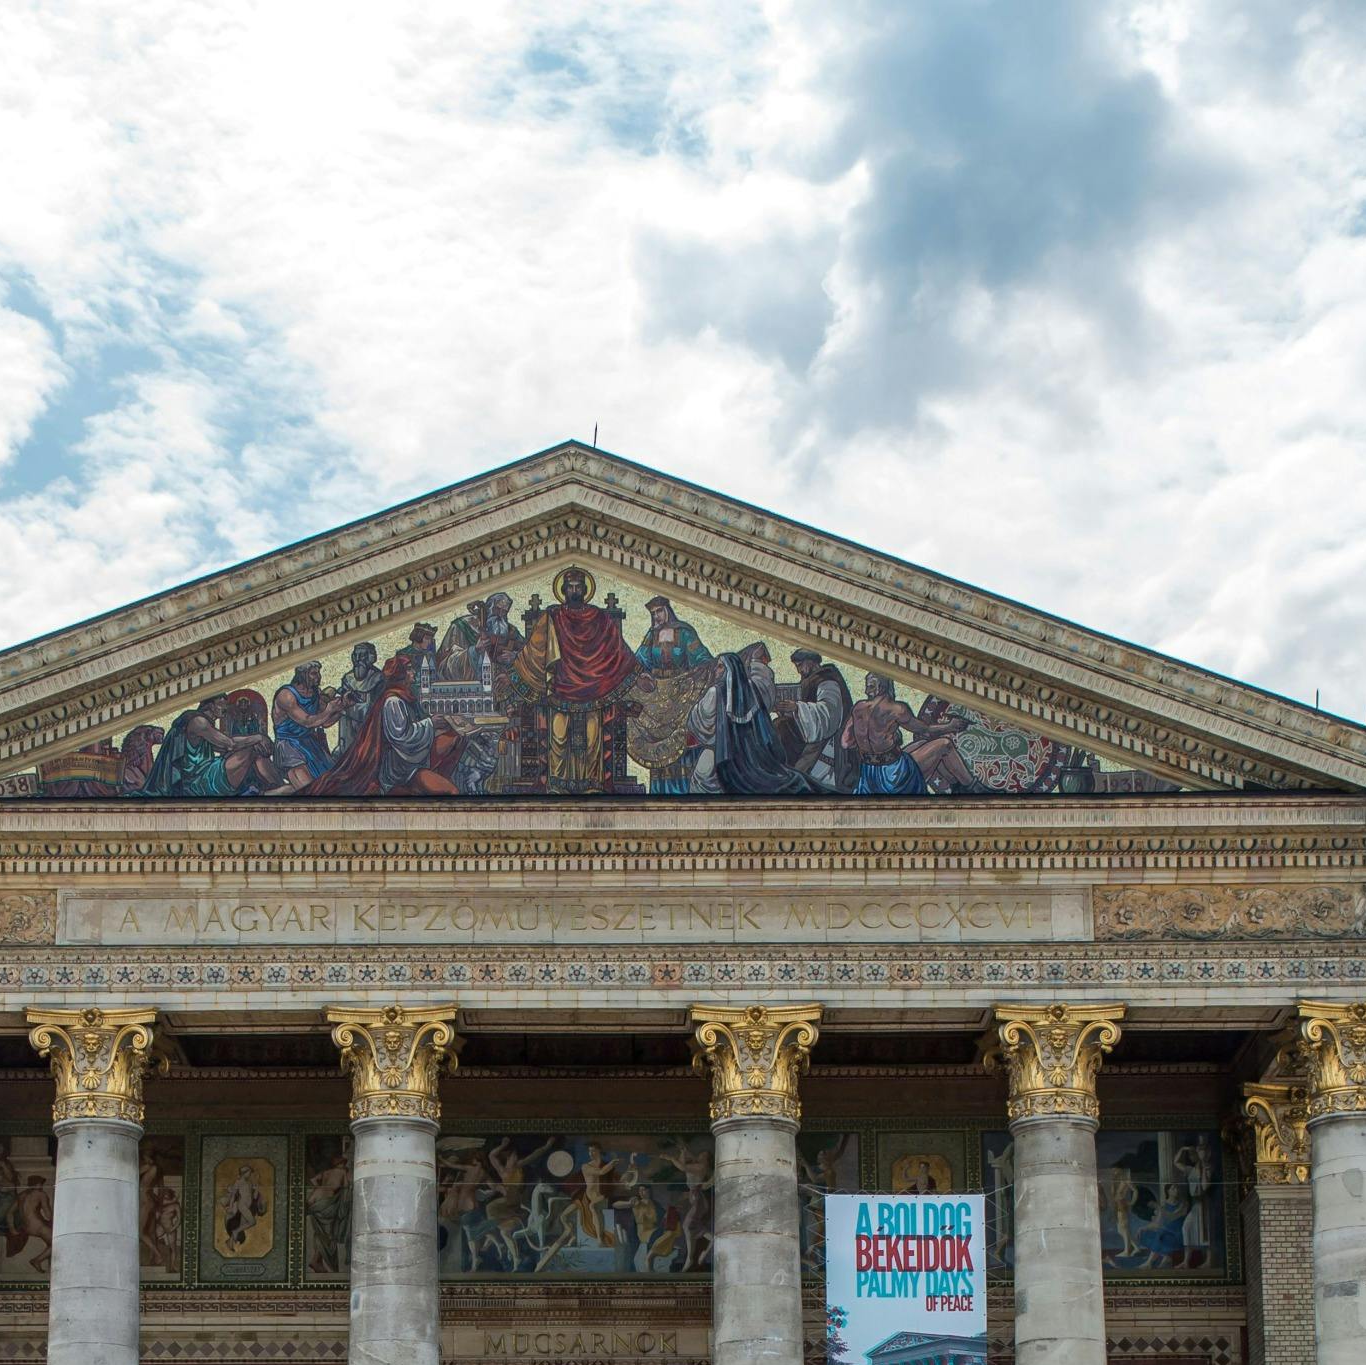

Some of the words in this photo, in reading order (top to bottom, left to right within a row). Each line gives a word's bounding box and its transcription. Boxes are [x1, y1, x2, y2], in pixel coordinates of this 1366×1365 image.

[118, 905, 142, 933] A
[164, 904, 332, 933] MAGYAR
[353, 897, 762, 932] KÉPZŐMŰVÉSZETNEK
[783, 901, 1033, 930] MDCCCXCVI
[856, 1203, 873, 1238] A
[878, 1202, 972, 1240] BOLDOG
[855, 1225, 974, 1272] BÉKEIDŐK
[856, 1270, 921, 1298] PALMY
[925, 1270, 974, 1297] DAYS
[926, 1295, 940, 1312] OF
[941, 1295, 974, 1312] PEACE
